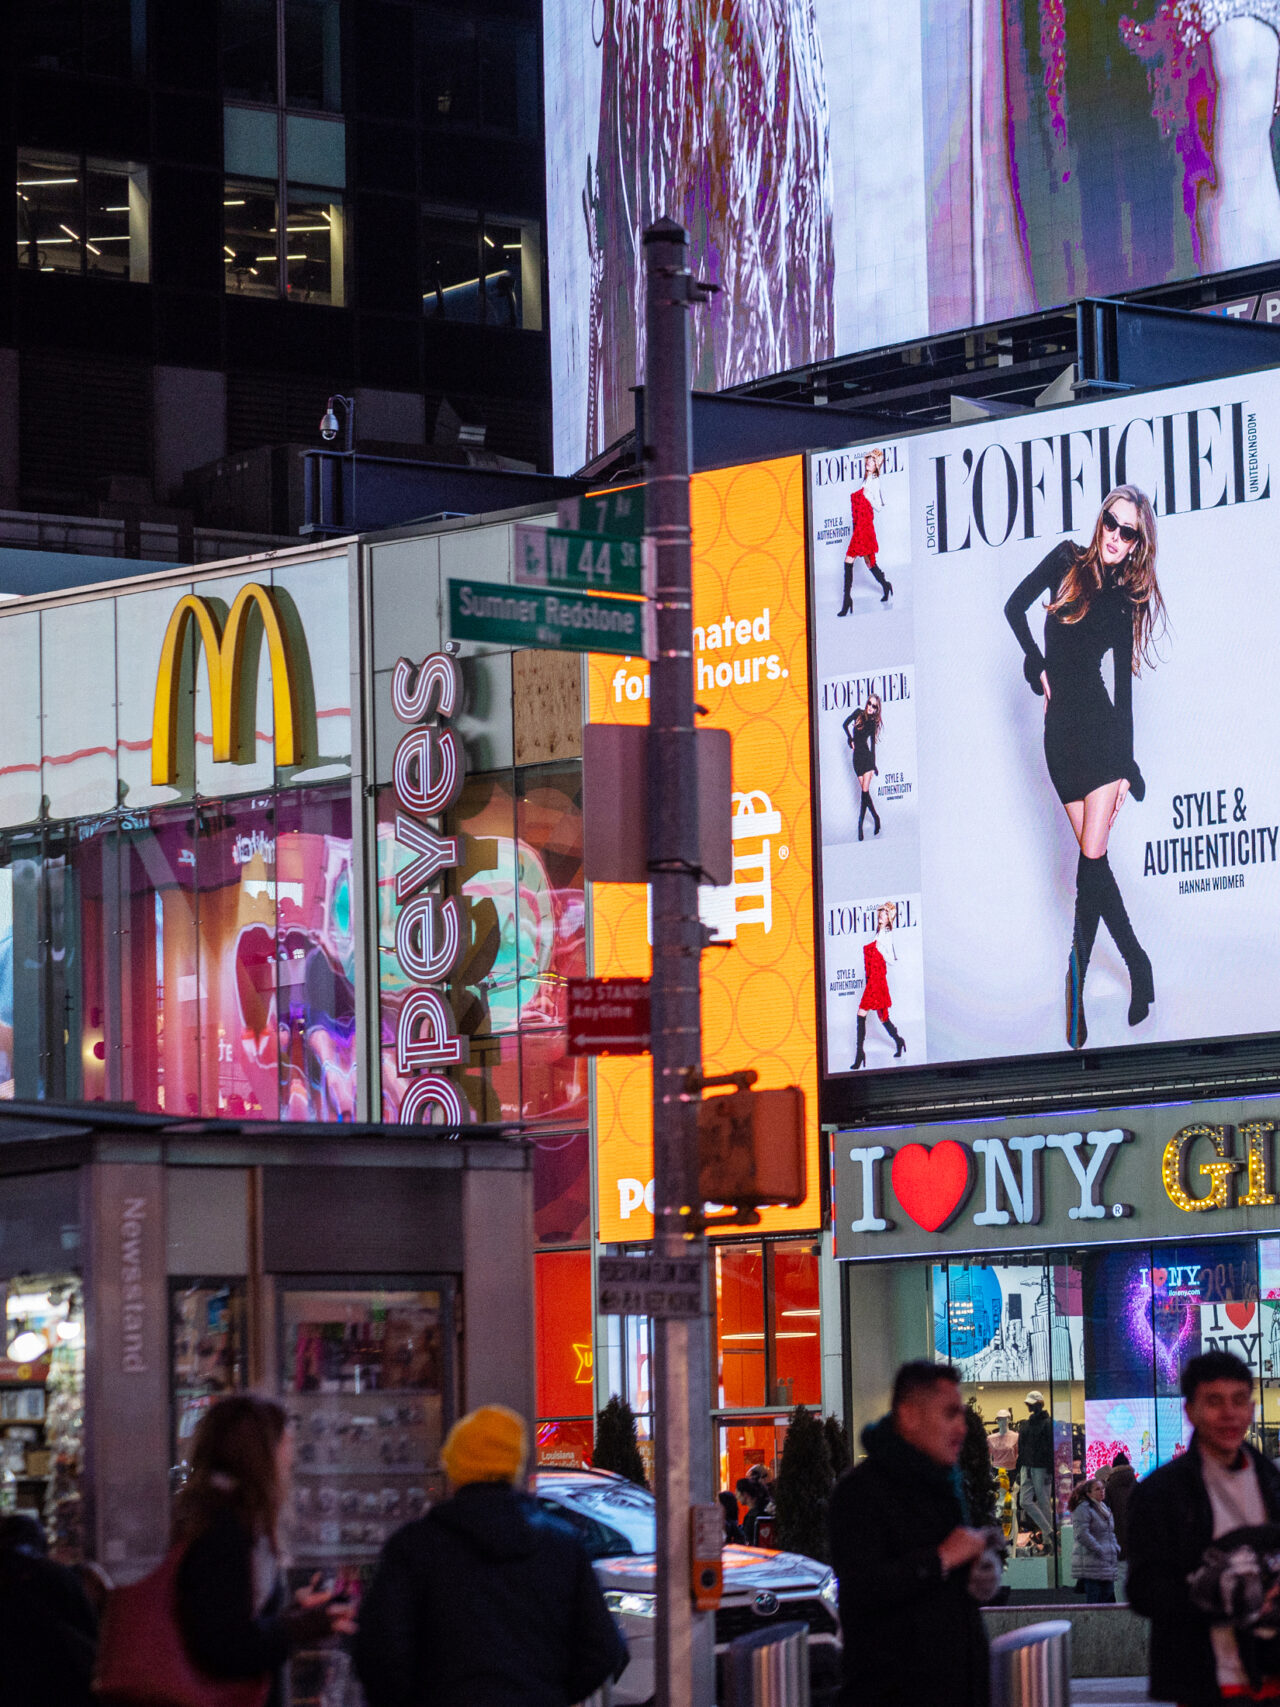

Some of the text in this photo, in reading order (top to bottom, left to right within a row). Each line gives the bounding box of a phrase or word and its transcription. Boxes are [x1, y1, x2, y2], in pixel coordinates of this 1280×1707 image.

[818, 446, 904, 487] L'OFFIEL
[930, 401, 1270, 555] L'OFFICIEL
[596, 500, 608, 534] 7
[926, 500, 935, 549] DIGITAL
[551, 536, 569, 580] W
[578, 540, 612, 584] 44
[459, 586, 635, 634] Sumner Redstone
[697, 654, 789, 690] hours.
[1172, 787, 1247, 830] STYLE &
[1144, 826, 1279, 877] AUTHENTICITY
[1179, 874, 1245, 895] HANNAH WIDMER
[831, 900, 917, 936] L'OFFIEL
[574, 1004, 633, 1021] Anytime
[849, 1146, 886, 1232] I
[121, 1198, 147, 1372] Newsstand
